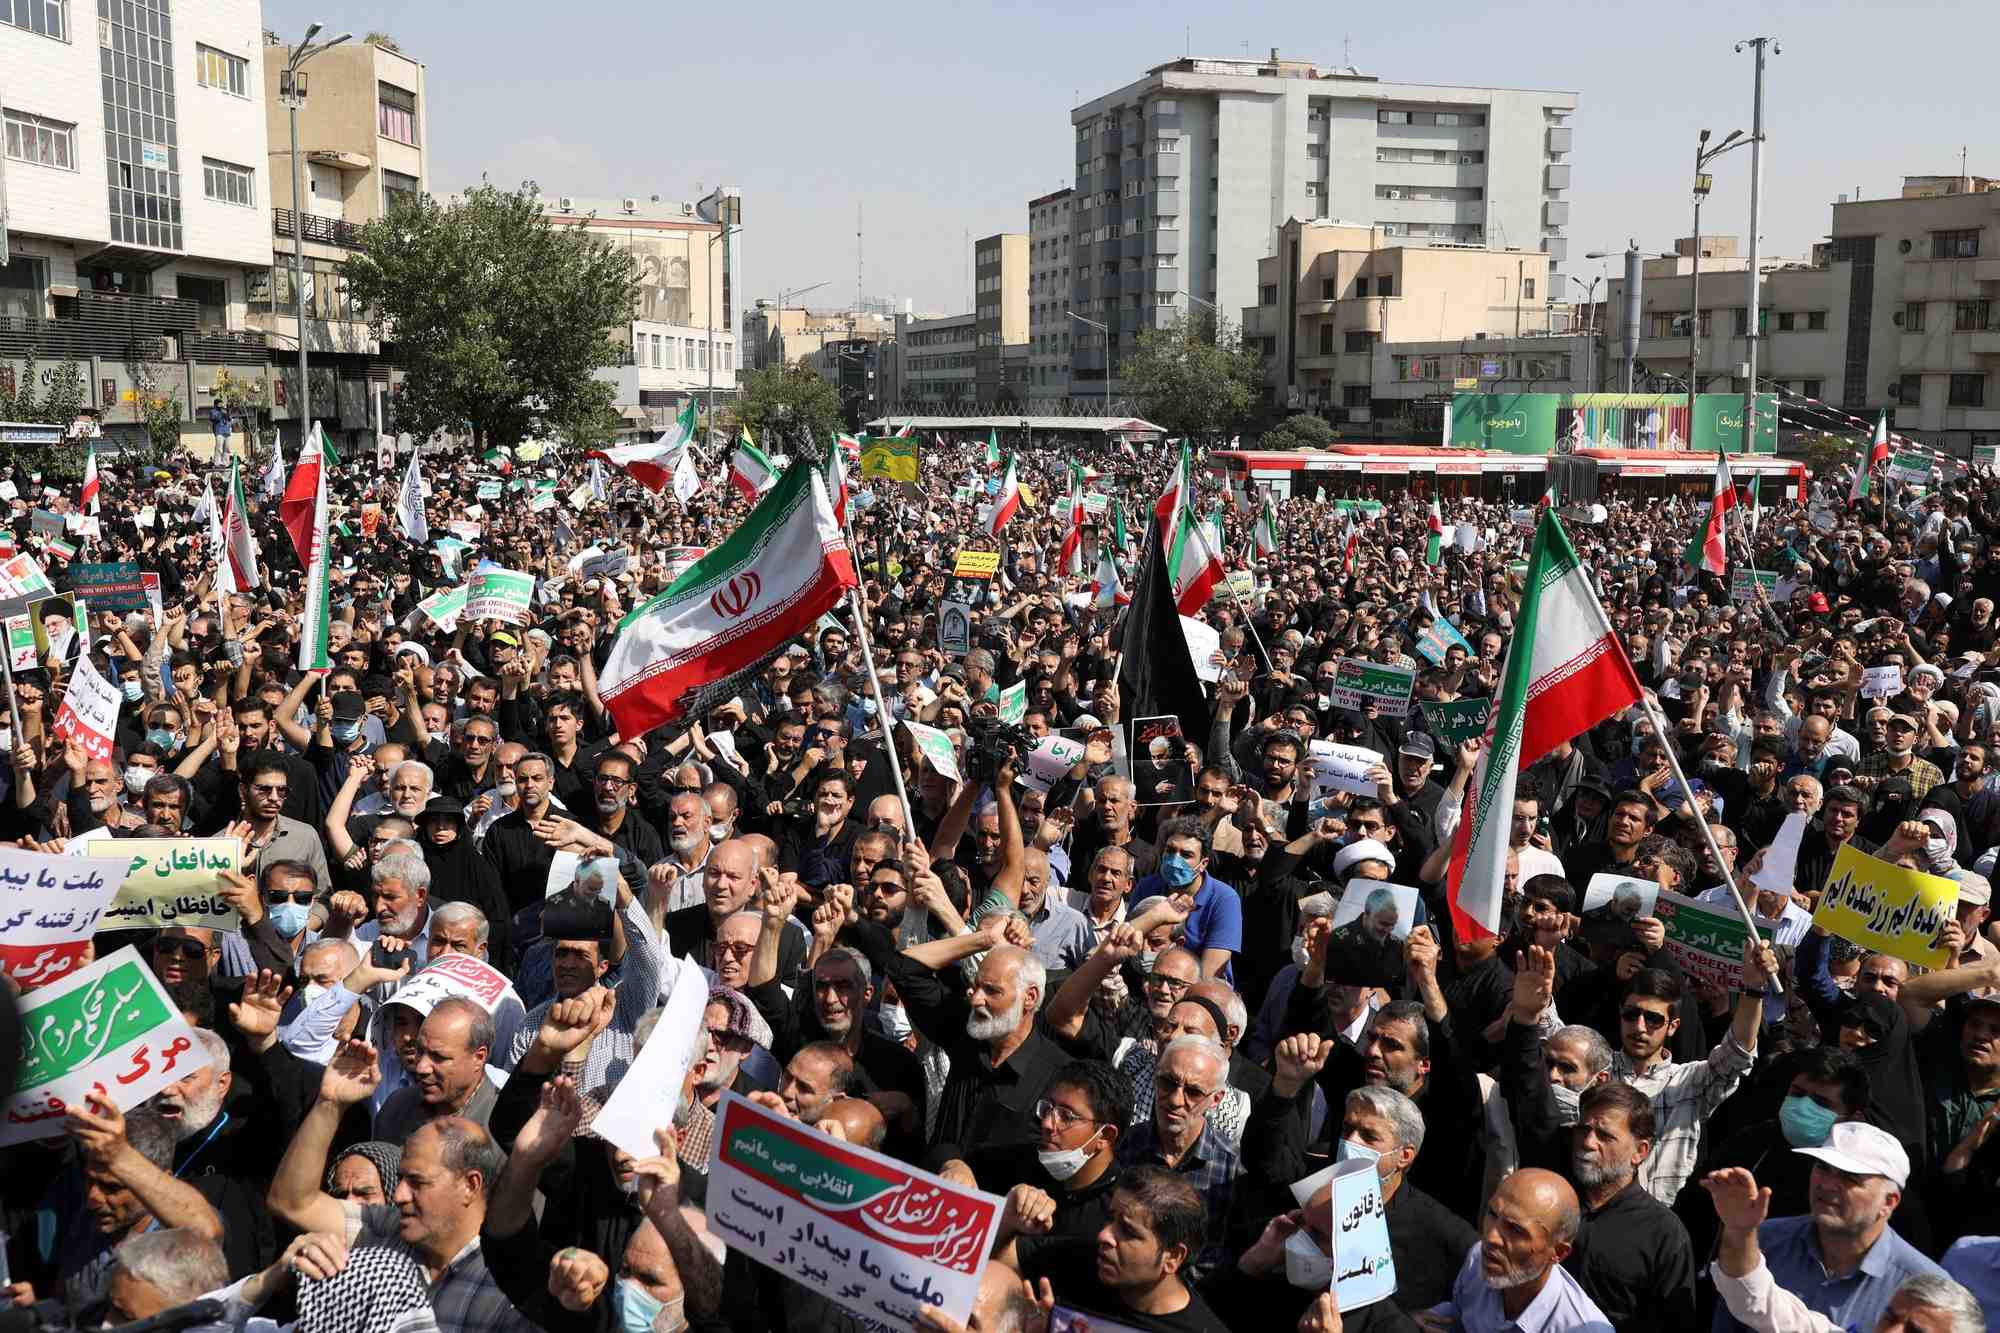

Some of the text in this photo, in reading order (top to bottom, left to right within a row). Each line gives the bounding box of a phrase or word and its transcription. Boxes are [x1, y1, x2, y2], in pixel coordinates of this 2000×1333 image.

[1451, 712, 1473, 729] رهبر
[36, 867, 57, 889] ما
[63, 870, 104, 890] ملت
[126, 847, 232, 878] مدافعان حر
[160, 895, 232, 921] حافظان
[1823, 869, 1853, 911] ایم
[1846, 884, 1889, 933] رزمنده
[35, 907, 75, 929] فتنه
[71, 907, 101, 933] از
[1886, 891, 1920, 936] ایم
[11, 947, 73, 985] مرگ
[1687, 951, 1745, 975] OBEDIE
[38, 1014, 83, 1063] مردم
[116, 1036, 192, 1086] مرگ
[733, 1137, 854, 1199] انقلابی می مانیم
[713, 1210, 766, 1247] است
[1341, 1188, 1375, 1233] قانون
[730, 1185, 945, 1307] ملت ما بیدار است
[771, 1246, 829, 1287] بیزار
[1337, 1255, 1376, 1283] ملت
